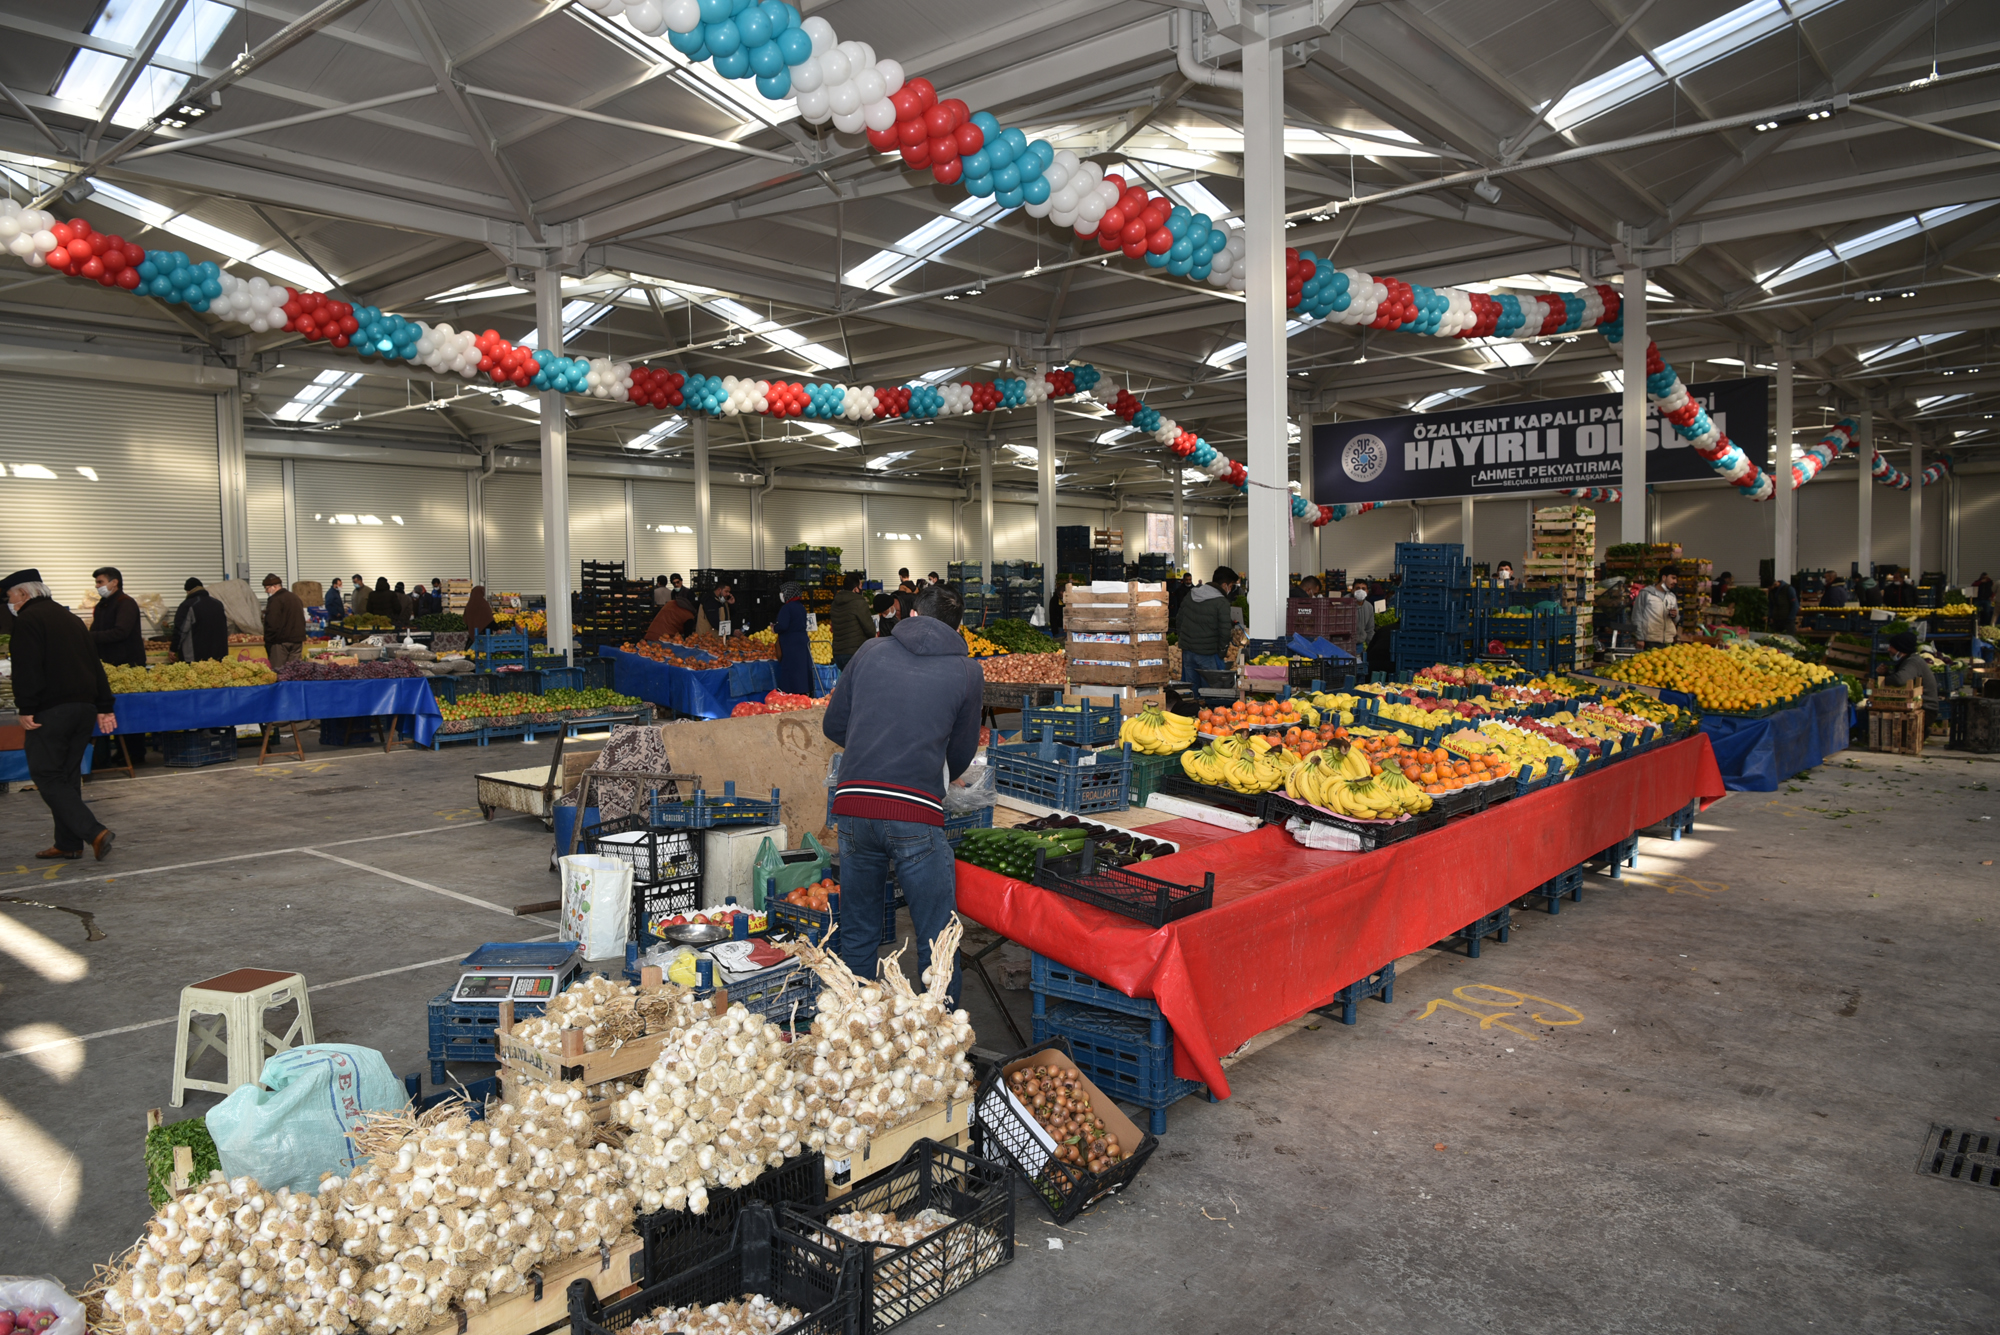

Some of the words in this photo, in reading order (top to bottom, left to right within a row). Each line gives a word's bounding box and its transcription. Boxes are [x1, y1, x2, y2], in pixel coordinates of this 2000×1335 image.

[1413, 416, 1510, 440] ÖZALKENT
[1514, 409, 1585, 430] KAPALI
[1590, 402, 1660, 423] PAZR
[1404, 428, 1560, 471] HAYIRLI
[1576, 412, 1727, 457] OLSU
[1478, 467, 1525, 481] AHMET
[1529, 460, 1623, 477] PEKYATIRMA
[1502, 477, 1538, 487] SELÇUKLU
[1540, 474, 1574, 484] BELEDİYE
[1575, 472, 1608, 482] BAŞKANI
